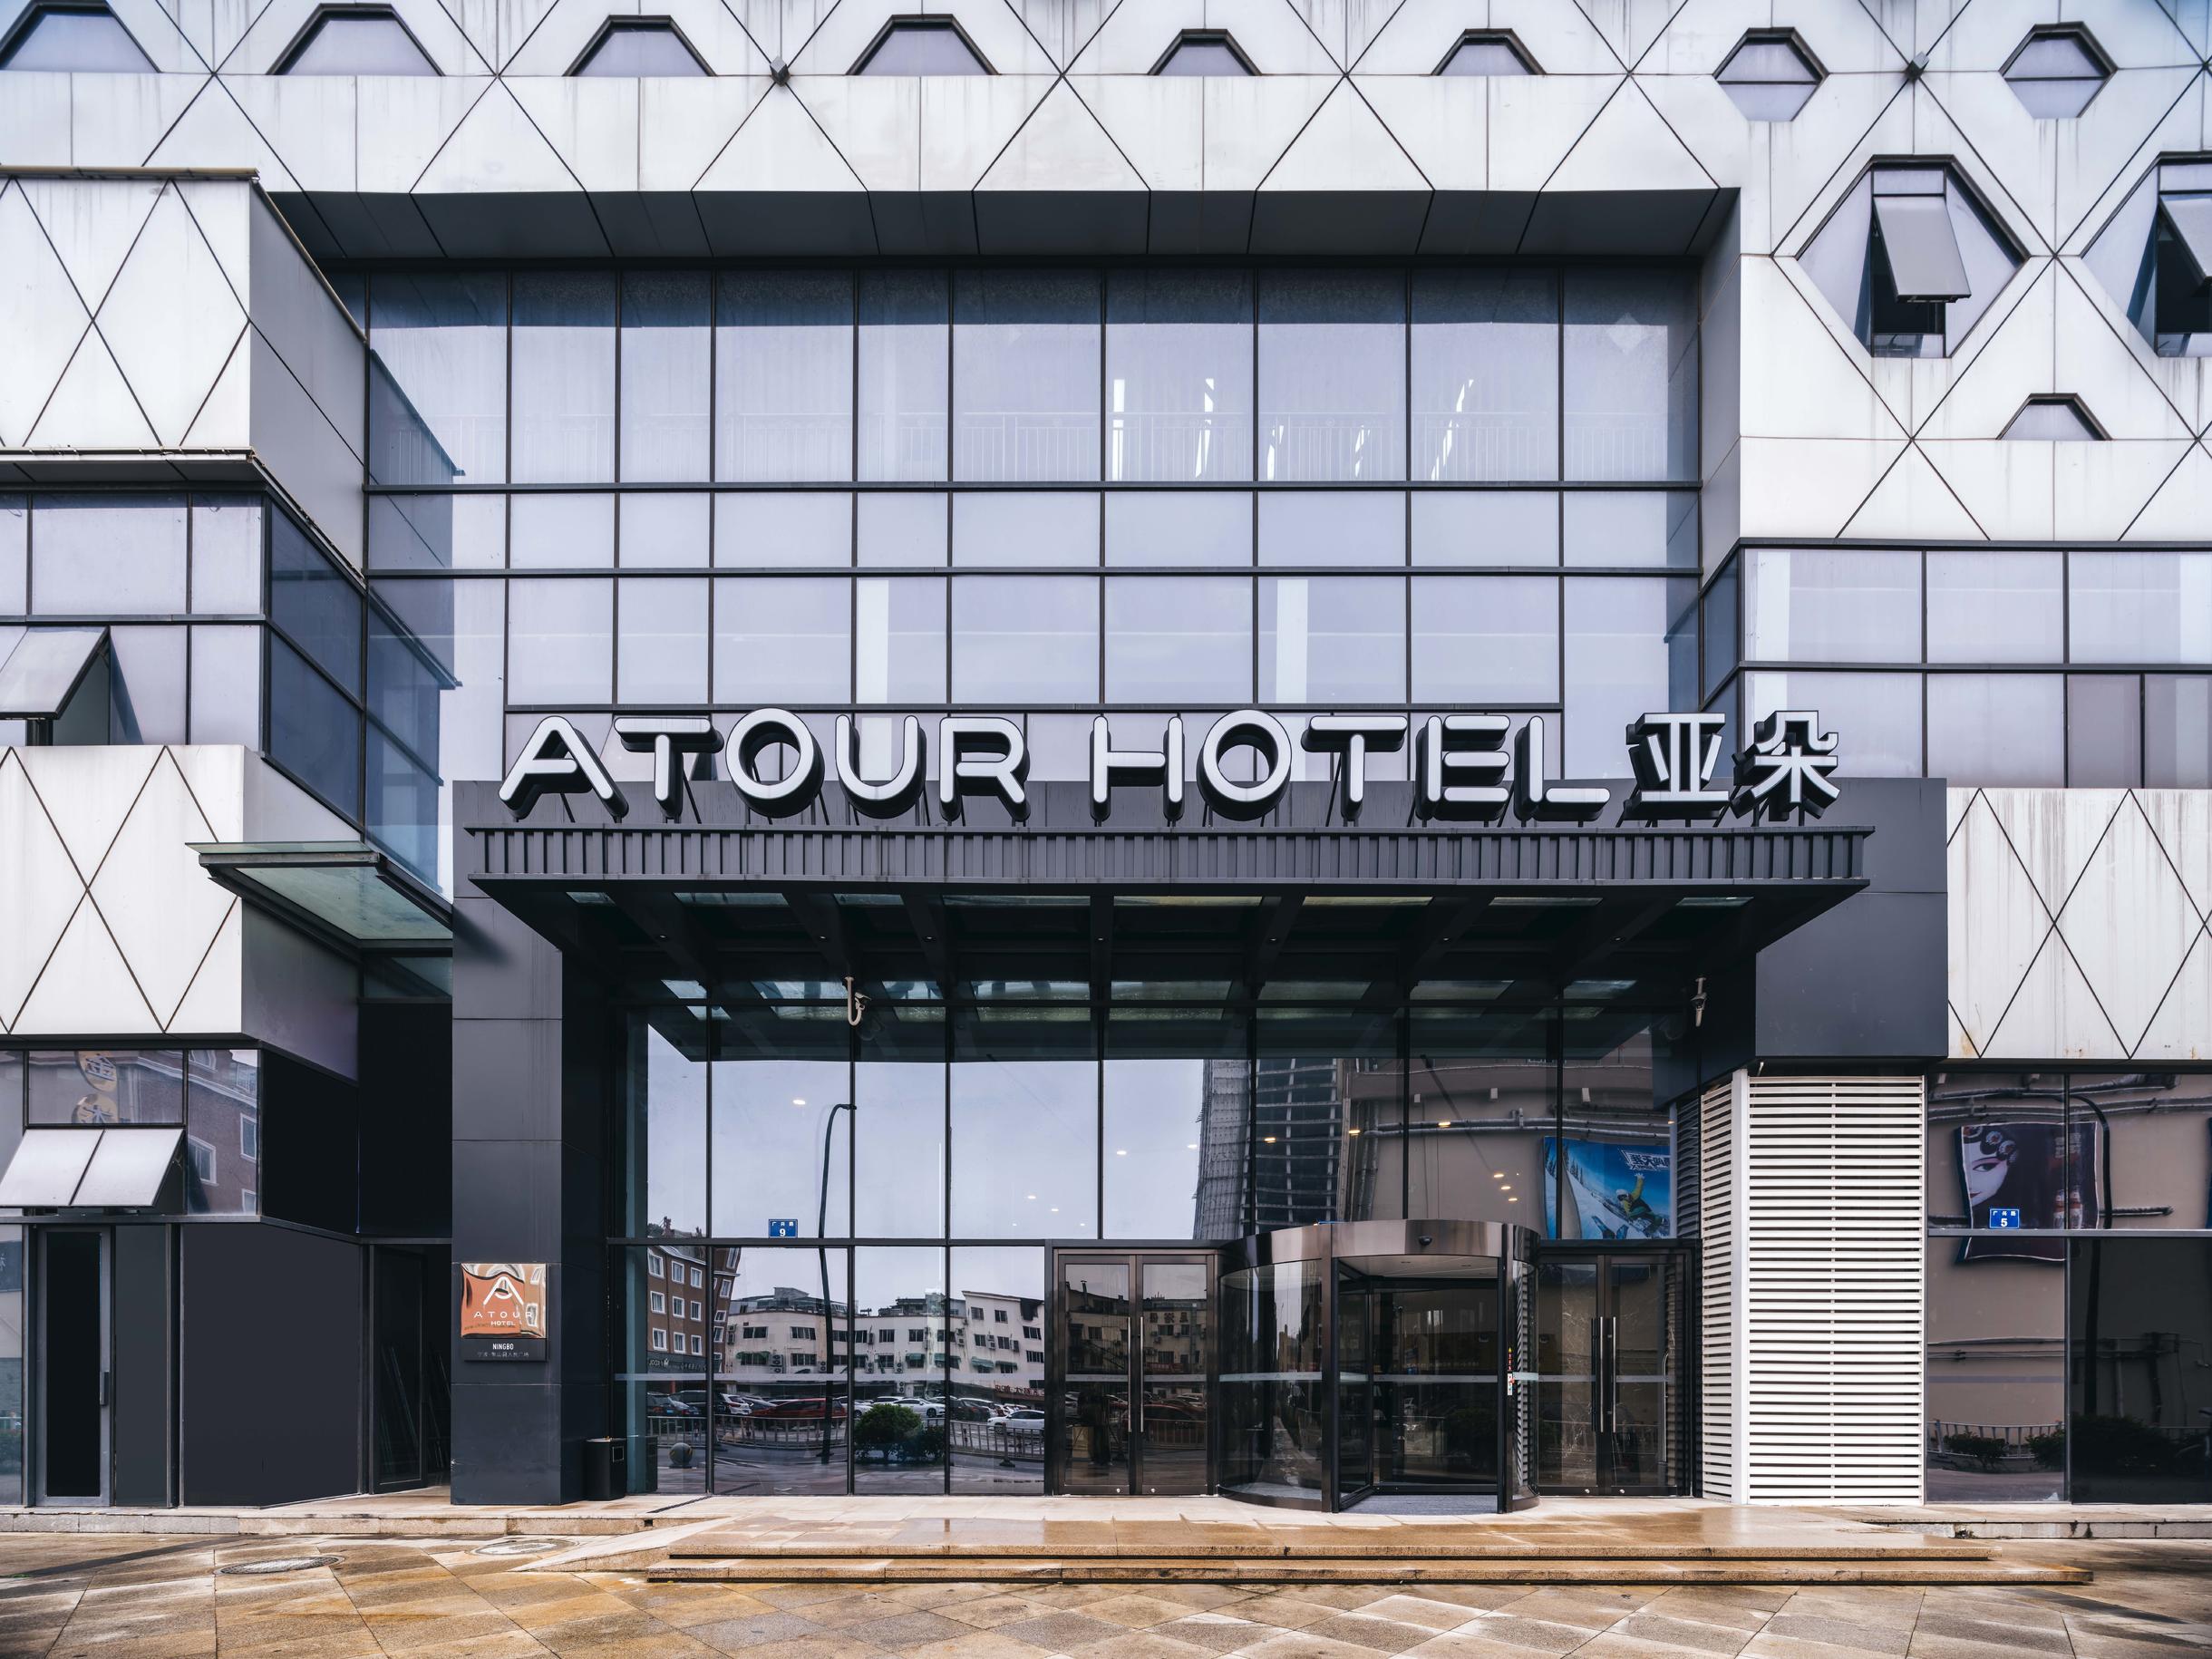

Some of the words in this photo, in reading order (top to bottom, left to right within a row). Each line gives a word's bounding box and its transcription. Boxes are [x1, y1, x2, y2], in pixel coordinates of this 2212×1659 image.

[499, 707, 1031, 819] ATOUR
[1091, 709, 1611, 820] HOTEL
[1626, 710, 1838, 821] 亚朵
[2000, 1218, 2008, 1227] 5
[779, 1227, 786, 1237] 9
[473, 1311, 533, 1319] ATOUR
